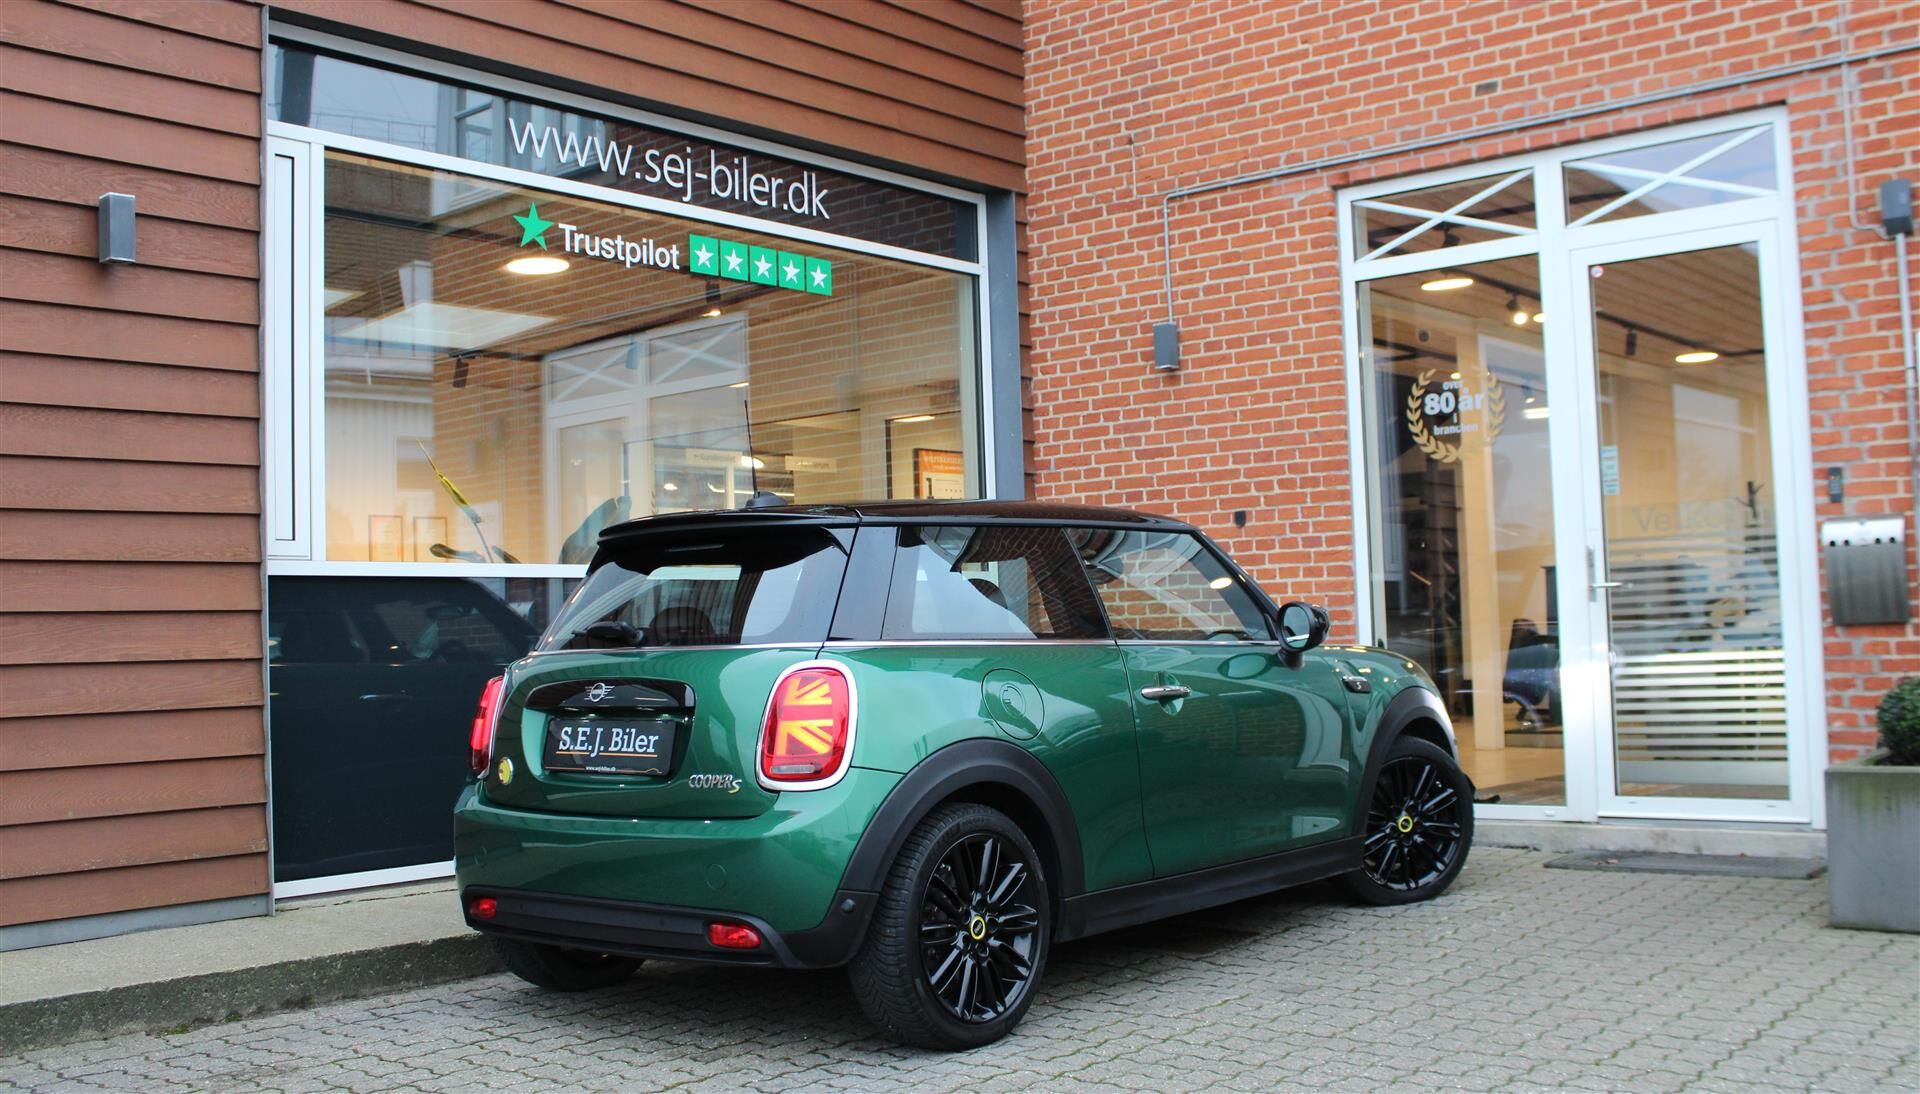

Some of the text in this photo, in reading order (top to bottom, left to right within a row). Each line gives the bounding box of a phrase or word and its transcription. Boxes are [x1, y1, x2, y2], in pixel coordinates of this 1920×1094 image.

[509, 117, 830, 219] www.sej-biler.dk
[558, 223, 680, 270] Trustpilot
[1443, 381, 1463, 390] over
[1424, 387, 1485, 415] 80 år
[559, 726, 659, 757] S.E.J. Biler
[689, 774, 733, 788] COOPER
